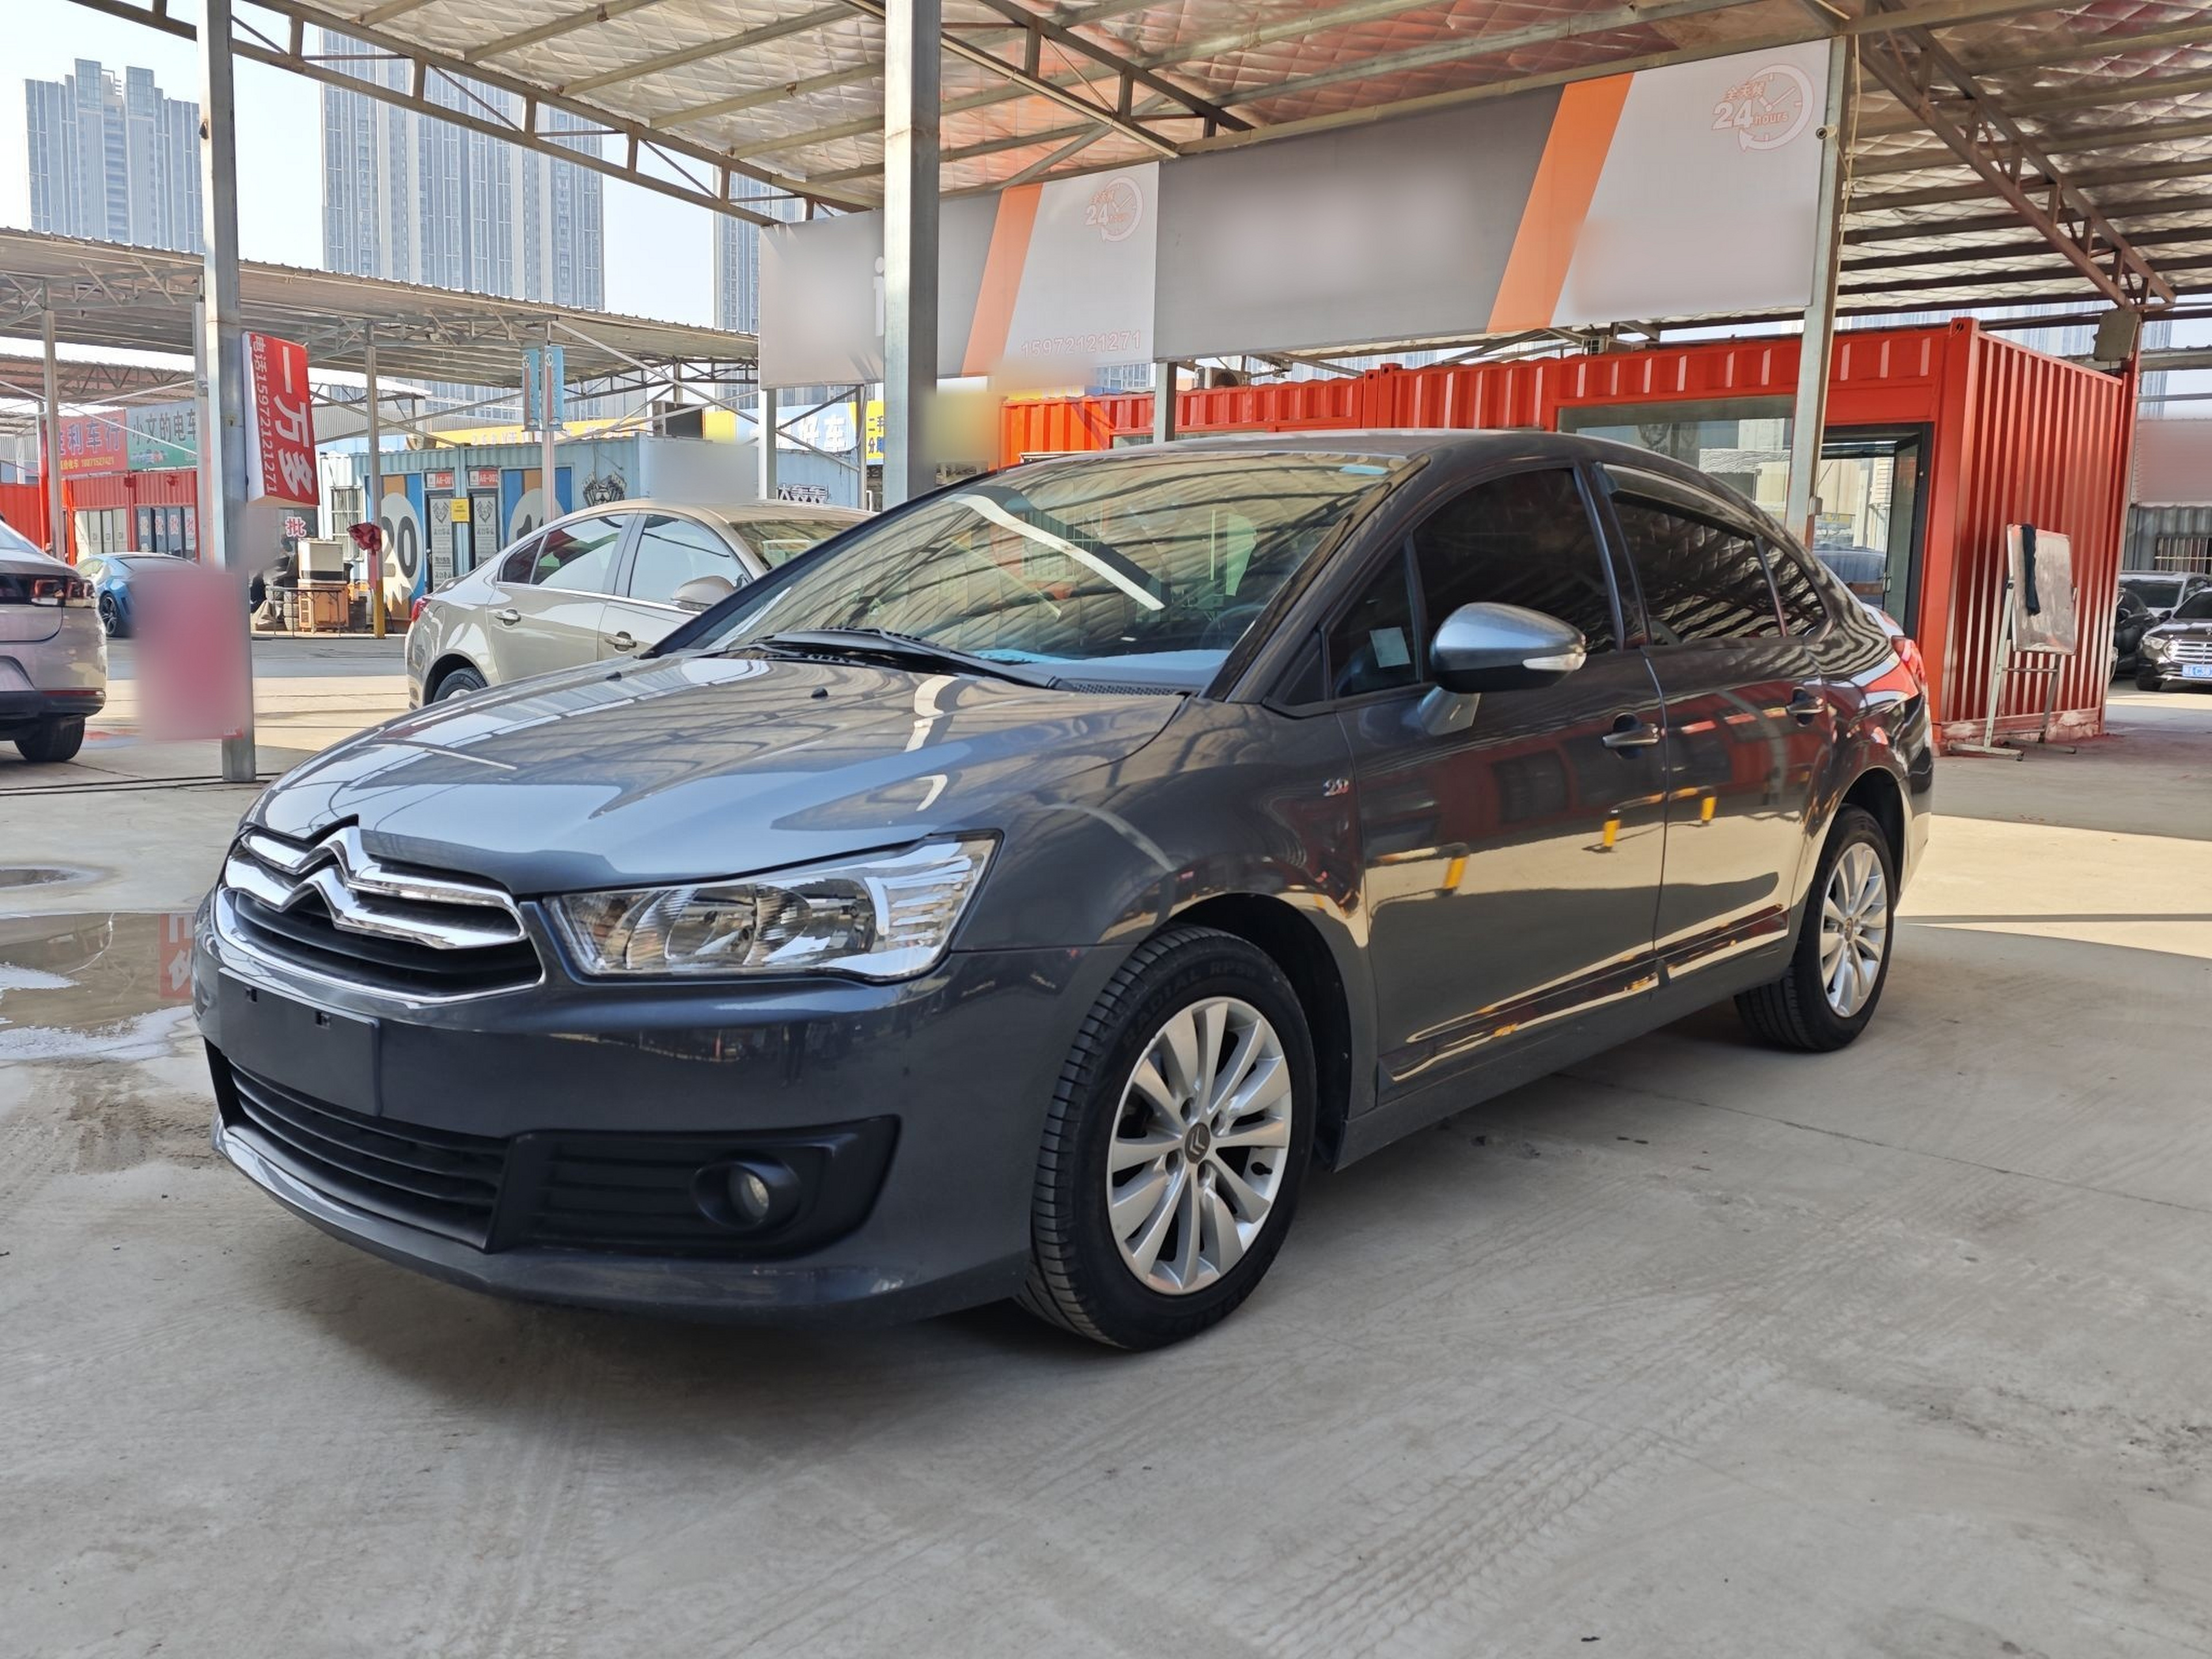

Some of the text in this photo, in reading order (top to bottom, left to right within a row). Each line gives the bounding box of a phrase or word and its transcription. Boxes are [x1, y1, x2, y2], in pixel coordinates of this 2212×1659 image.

[1725, 80, 1766, 102] 全天候
[1711, 99, 1789, 130] 24 hours
[1084, 203, 1108, 226] 24
[1021, 329, 1141, 358] 15972121271
[273, 346, 313, 497] 一万多
